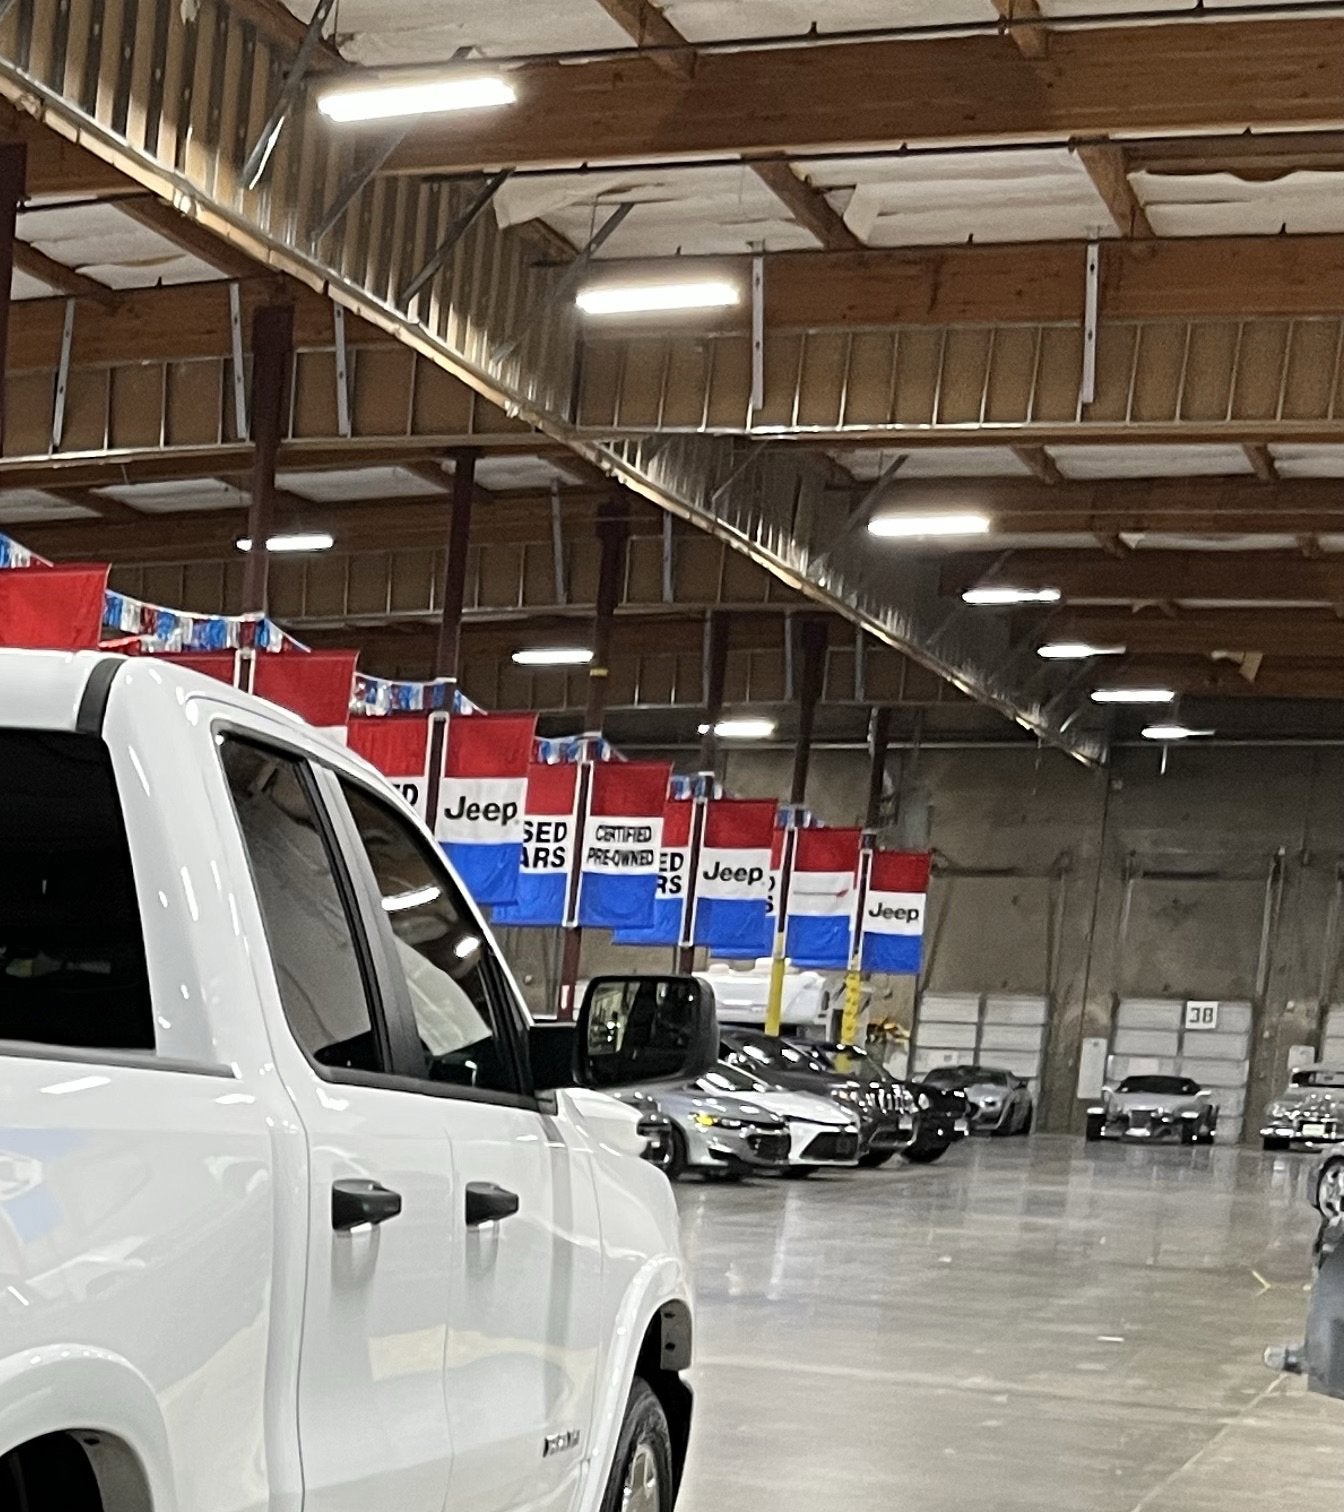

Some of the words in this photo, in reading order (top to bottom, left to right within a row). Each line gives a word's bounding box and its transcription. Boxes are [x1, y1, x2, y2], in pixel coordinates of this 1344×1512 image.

[444, 795, 518, 827] Jeep
[523, 820, 568, 843] SED
[595, 824, 652, 843] CERTIFIED
[520, 846, 566, 869] ARS
[586, 846, 654, 867] PRE-OWNED
[659, 852, 684, 873] ED
[703, 861, 764, 885] Jeep
[657, 875, 683, 895] RS
[868, 902, 920, 924] Jeep
[1189, 1007, 1214, 1023] 38
